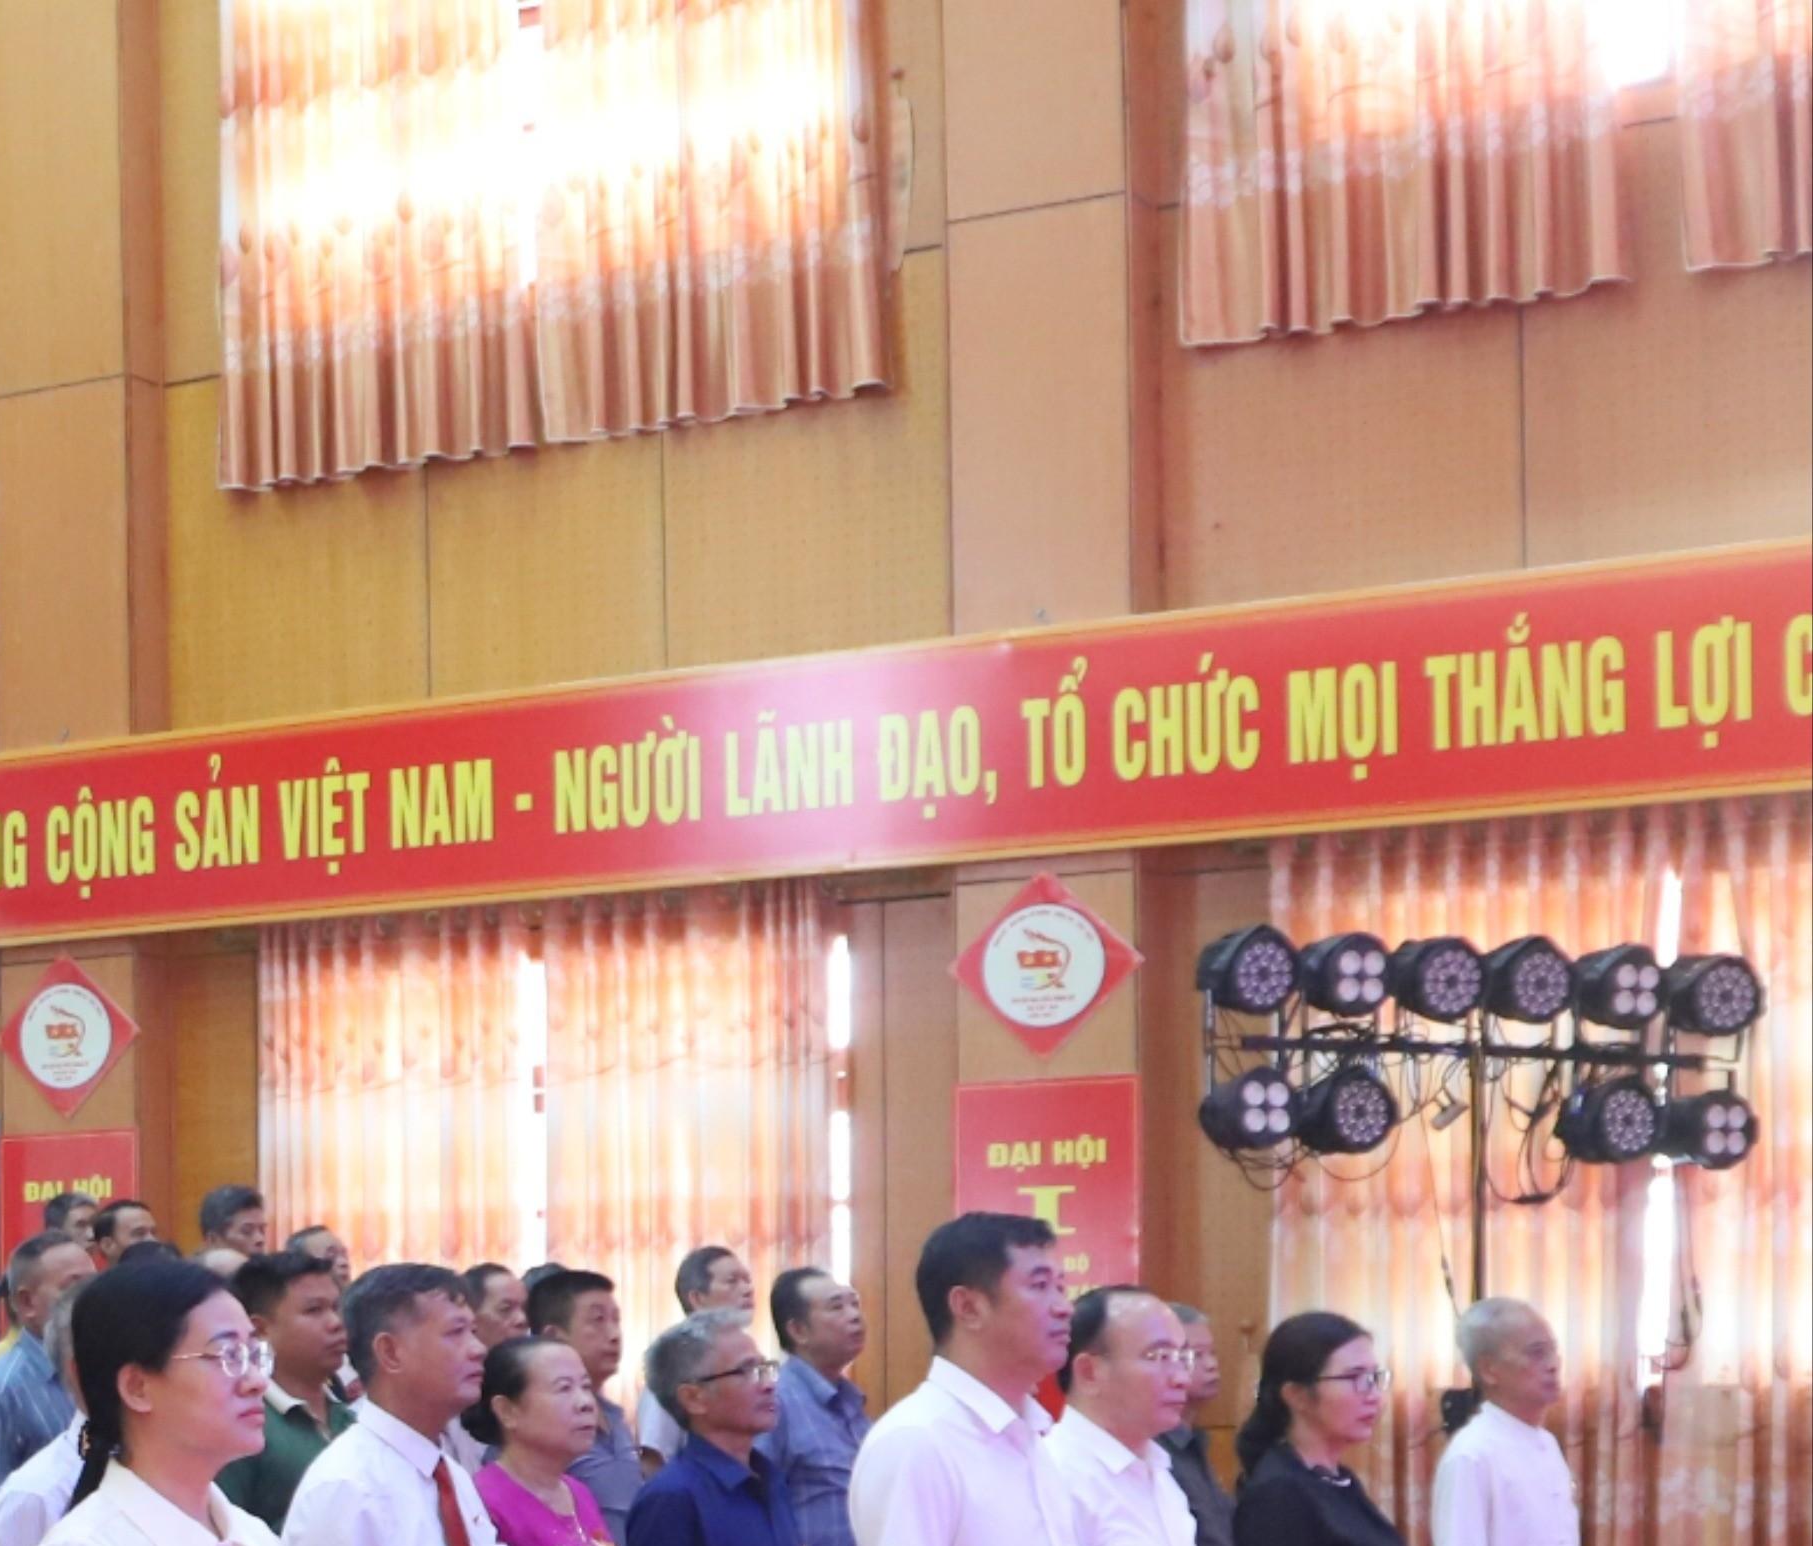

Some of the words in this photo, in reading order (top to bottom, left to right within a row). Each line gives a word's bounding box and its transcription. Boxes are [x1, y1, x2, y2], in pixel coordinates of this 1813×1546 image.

[45, 786, 156, 899] CỘNG
[175, 754, 260, 871] SẢN
[278, 758, 370, 874] VIỆT
[390, 759, 494, 849] NAM
[554, 715, 702, 833] NGƯỜI
[724, 711, 854, 819] LÃNH
[877, 705, 998, 819] ĐẠO,
[1021, 656, 1089, 788] TỔ
[1113, 652, 1261, 782] CHỨC
[1286, 660, 1399, 781] MỌI
[1424, 612, 1626, 752] THẮNG
[1655, 615, 1754, 748] LỢI
[986, 1139, 1042, 1173] ĐẠI
[1052, 1134, 1108, 1170] HỘI
